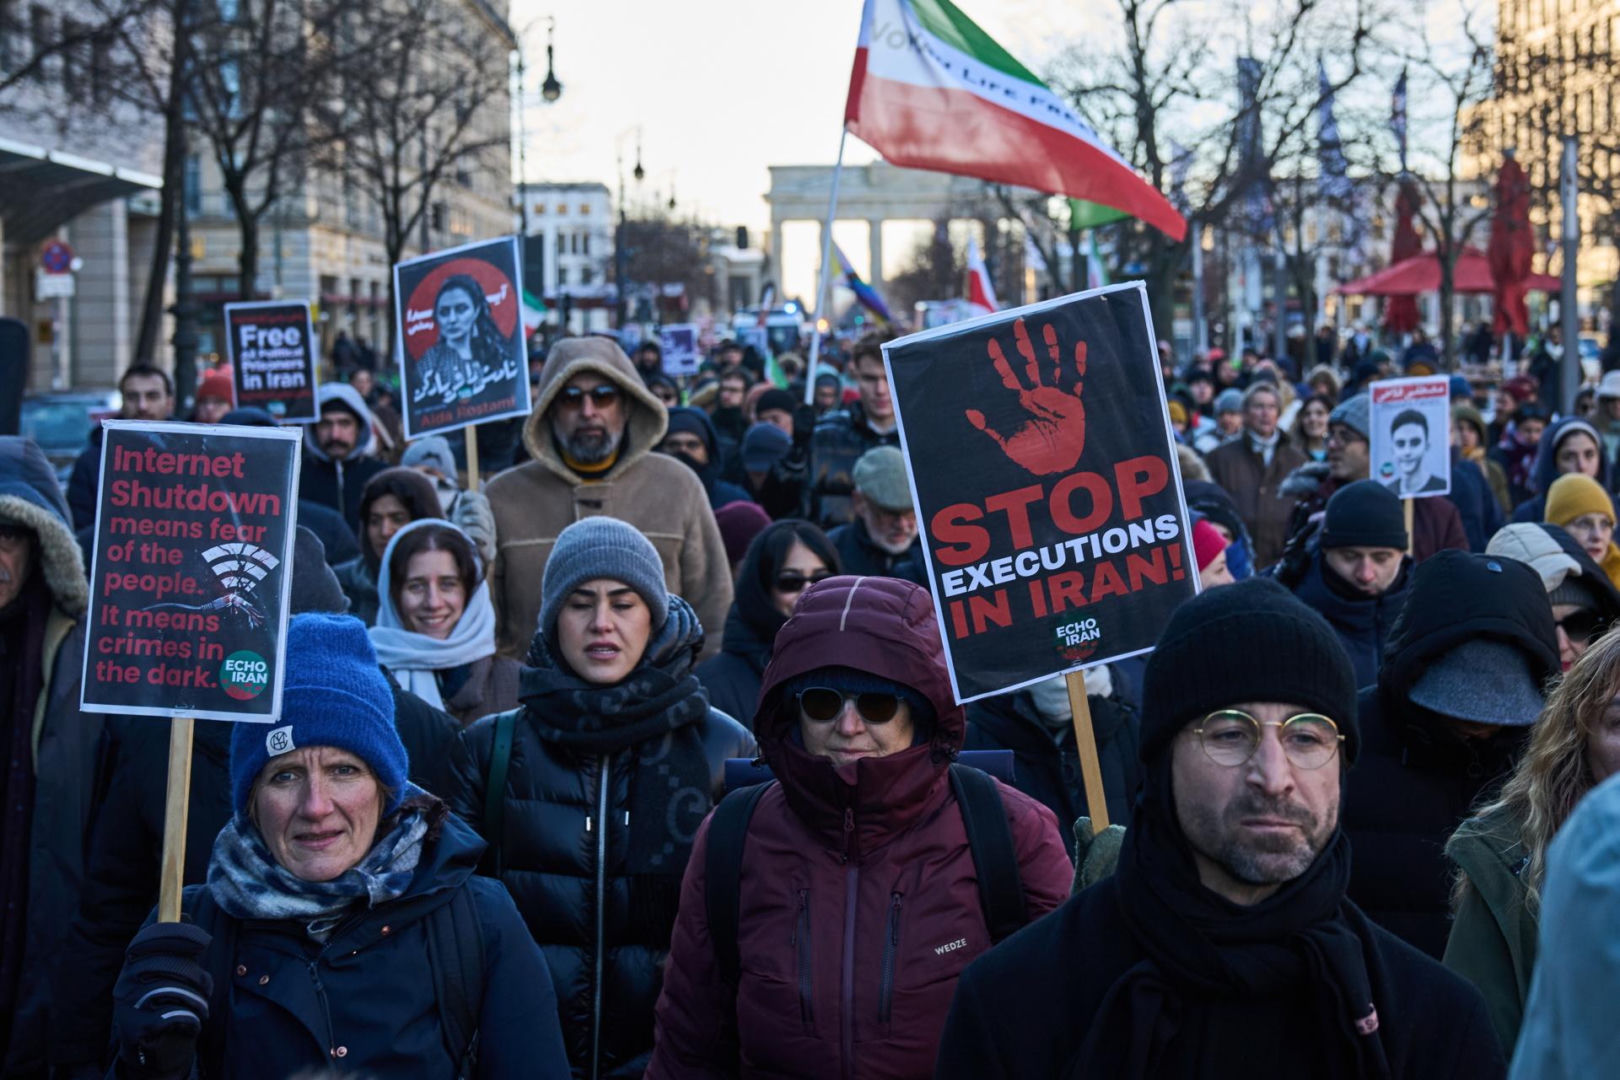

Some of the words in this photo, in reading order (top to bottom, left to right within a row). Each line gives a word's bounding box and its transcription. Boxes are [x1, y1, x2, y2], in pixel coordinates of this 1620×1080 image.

[240, 325, 301, 348] Free
[243, 372, 263, 390] in
[267, 371, 306, 389] Iran
[113, 445, 245, 478] Internet
[111, 480, 280, 515] Shutdown
[931, 455, 1169, 565] STOP
[110, 517, 203, 538] means
[210, 518, 267, 542] fear
[107, 540, 135, 561] of
[140, 541, 183, 564] the
[941, 514, 1179, 597] EXECUTIONS
[104, 572, 204, 599] people.
[950, 589, 1013, 639] IN
[1029, 543, 1185, 618] IRAN!
[101, 604, 119, 625] It
[125, 610, 220, 631] means
[1056, 618, 1096, 638] ECHO
[98, 632, 191, 659] crimes
[199, 637, 224, 660] in
[1065, 628, 1101, 646] IRAN
[96, 660, 140, 683] the
[147, 664, 217, 688] dark.
[225, 660, 266, 672] ECHO
[231, 671, 268, 684] IRAN
[934, 938, 967, 955] WEDZE
